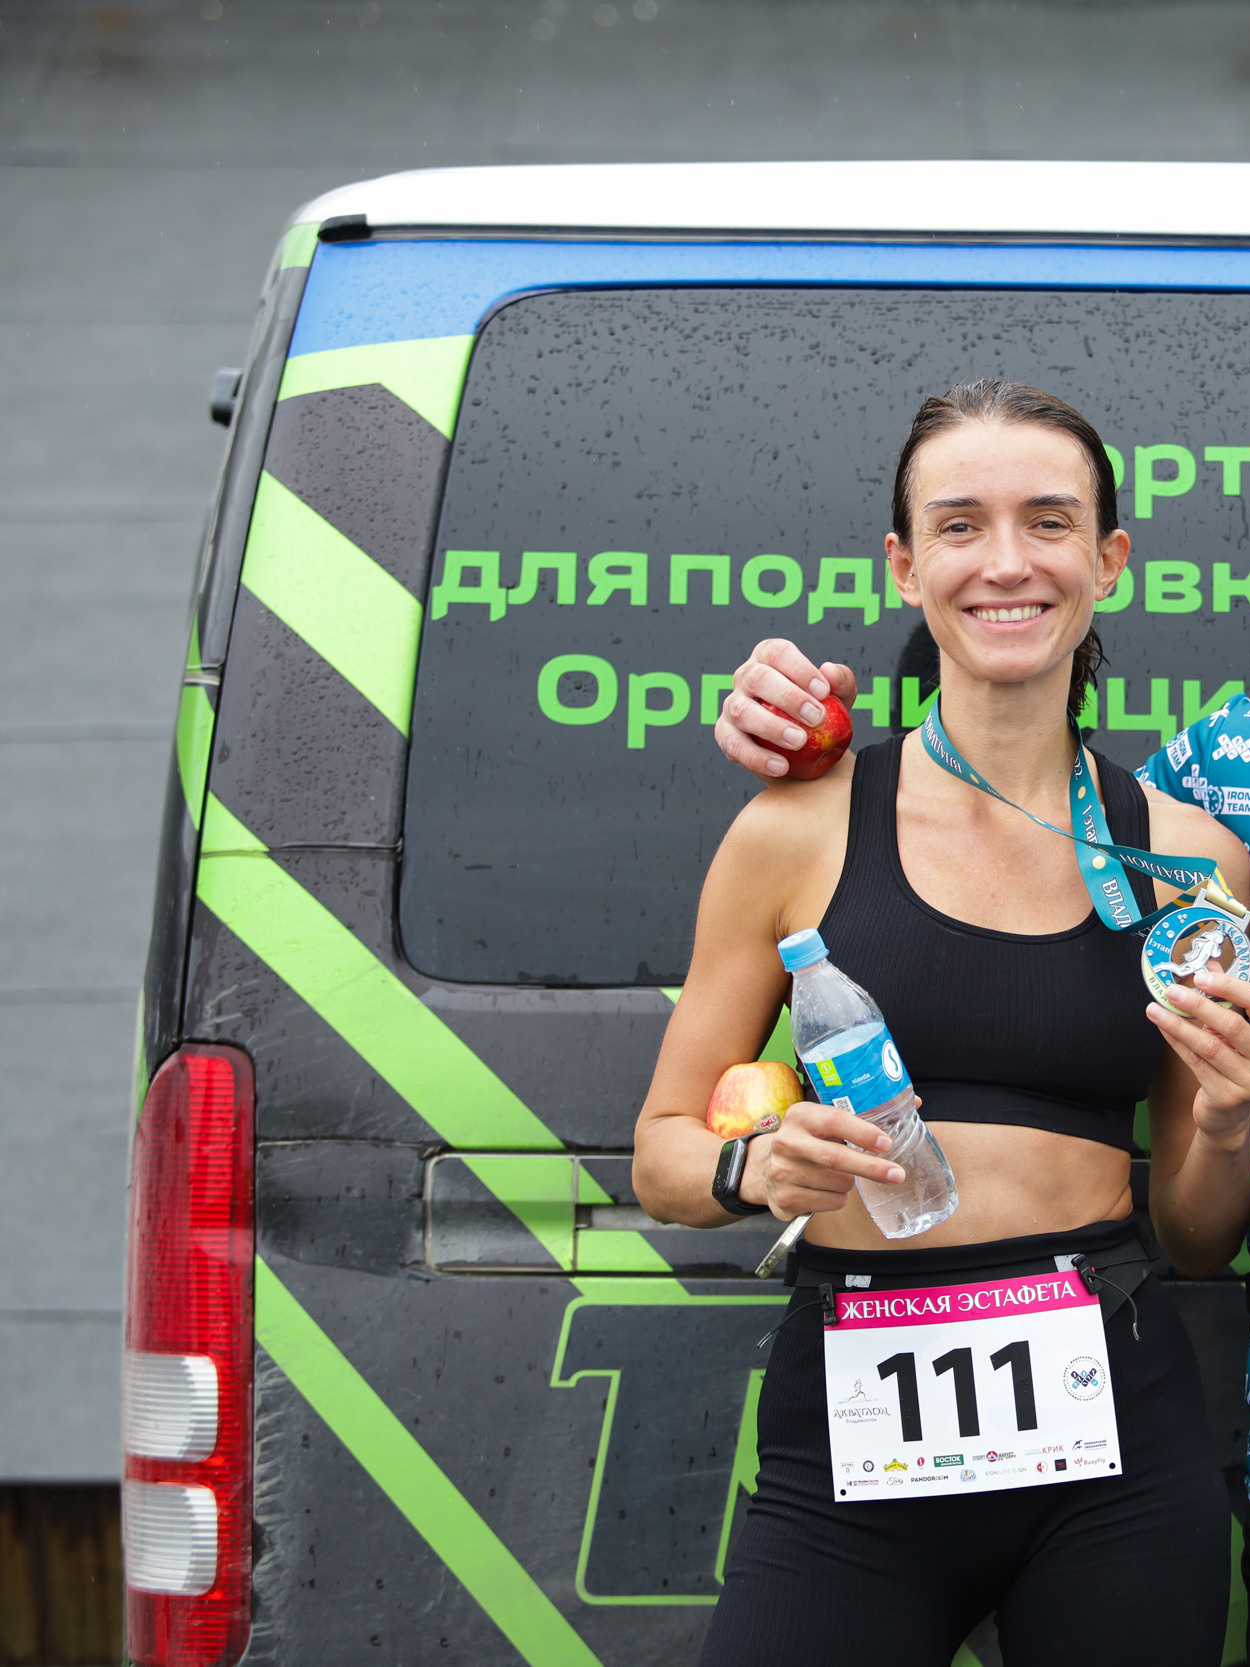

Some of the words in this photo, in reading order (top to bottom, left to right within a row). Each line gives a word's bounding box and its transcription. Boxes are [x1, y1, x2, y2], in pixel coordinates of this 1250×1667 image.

[432, 550, 648, 621] для
[1215, 920, 1250, 982] АКВАТЛО
[841, 1295, 951, 1320] ЖЕНСКАЯ
[958, 1280, 1077, 1312] ЭСТАФЕТА
[877, 1340, 1038, 1443] 111
[1042, 1445, 1064, 1454] КРИК
[1083, 1456, 1106, 1466] BusyFly
